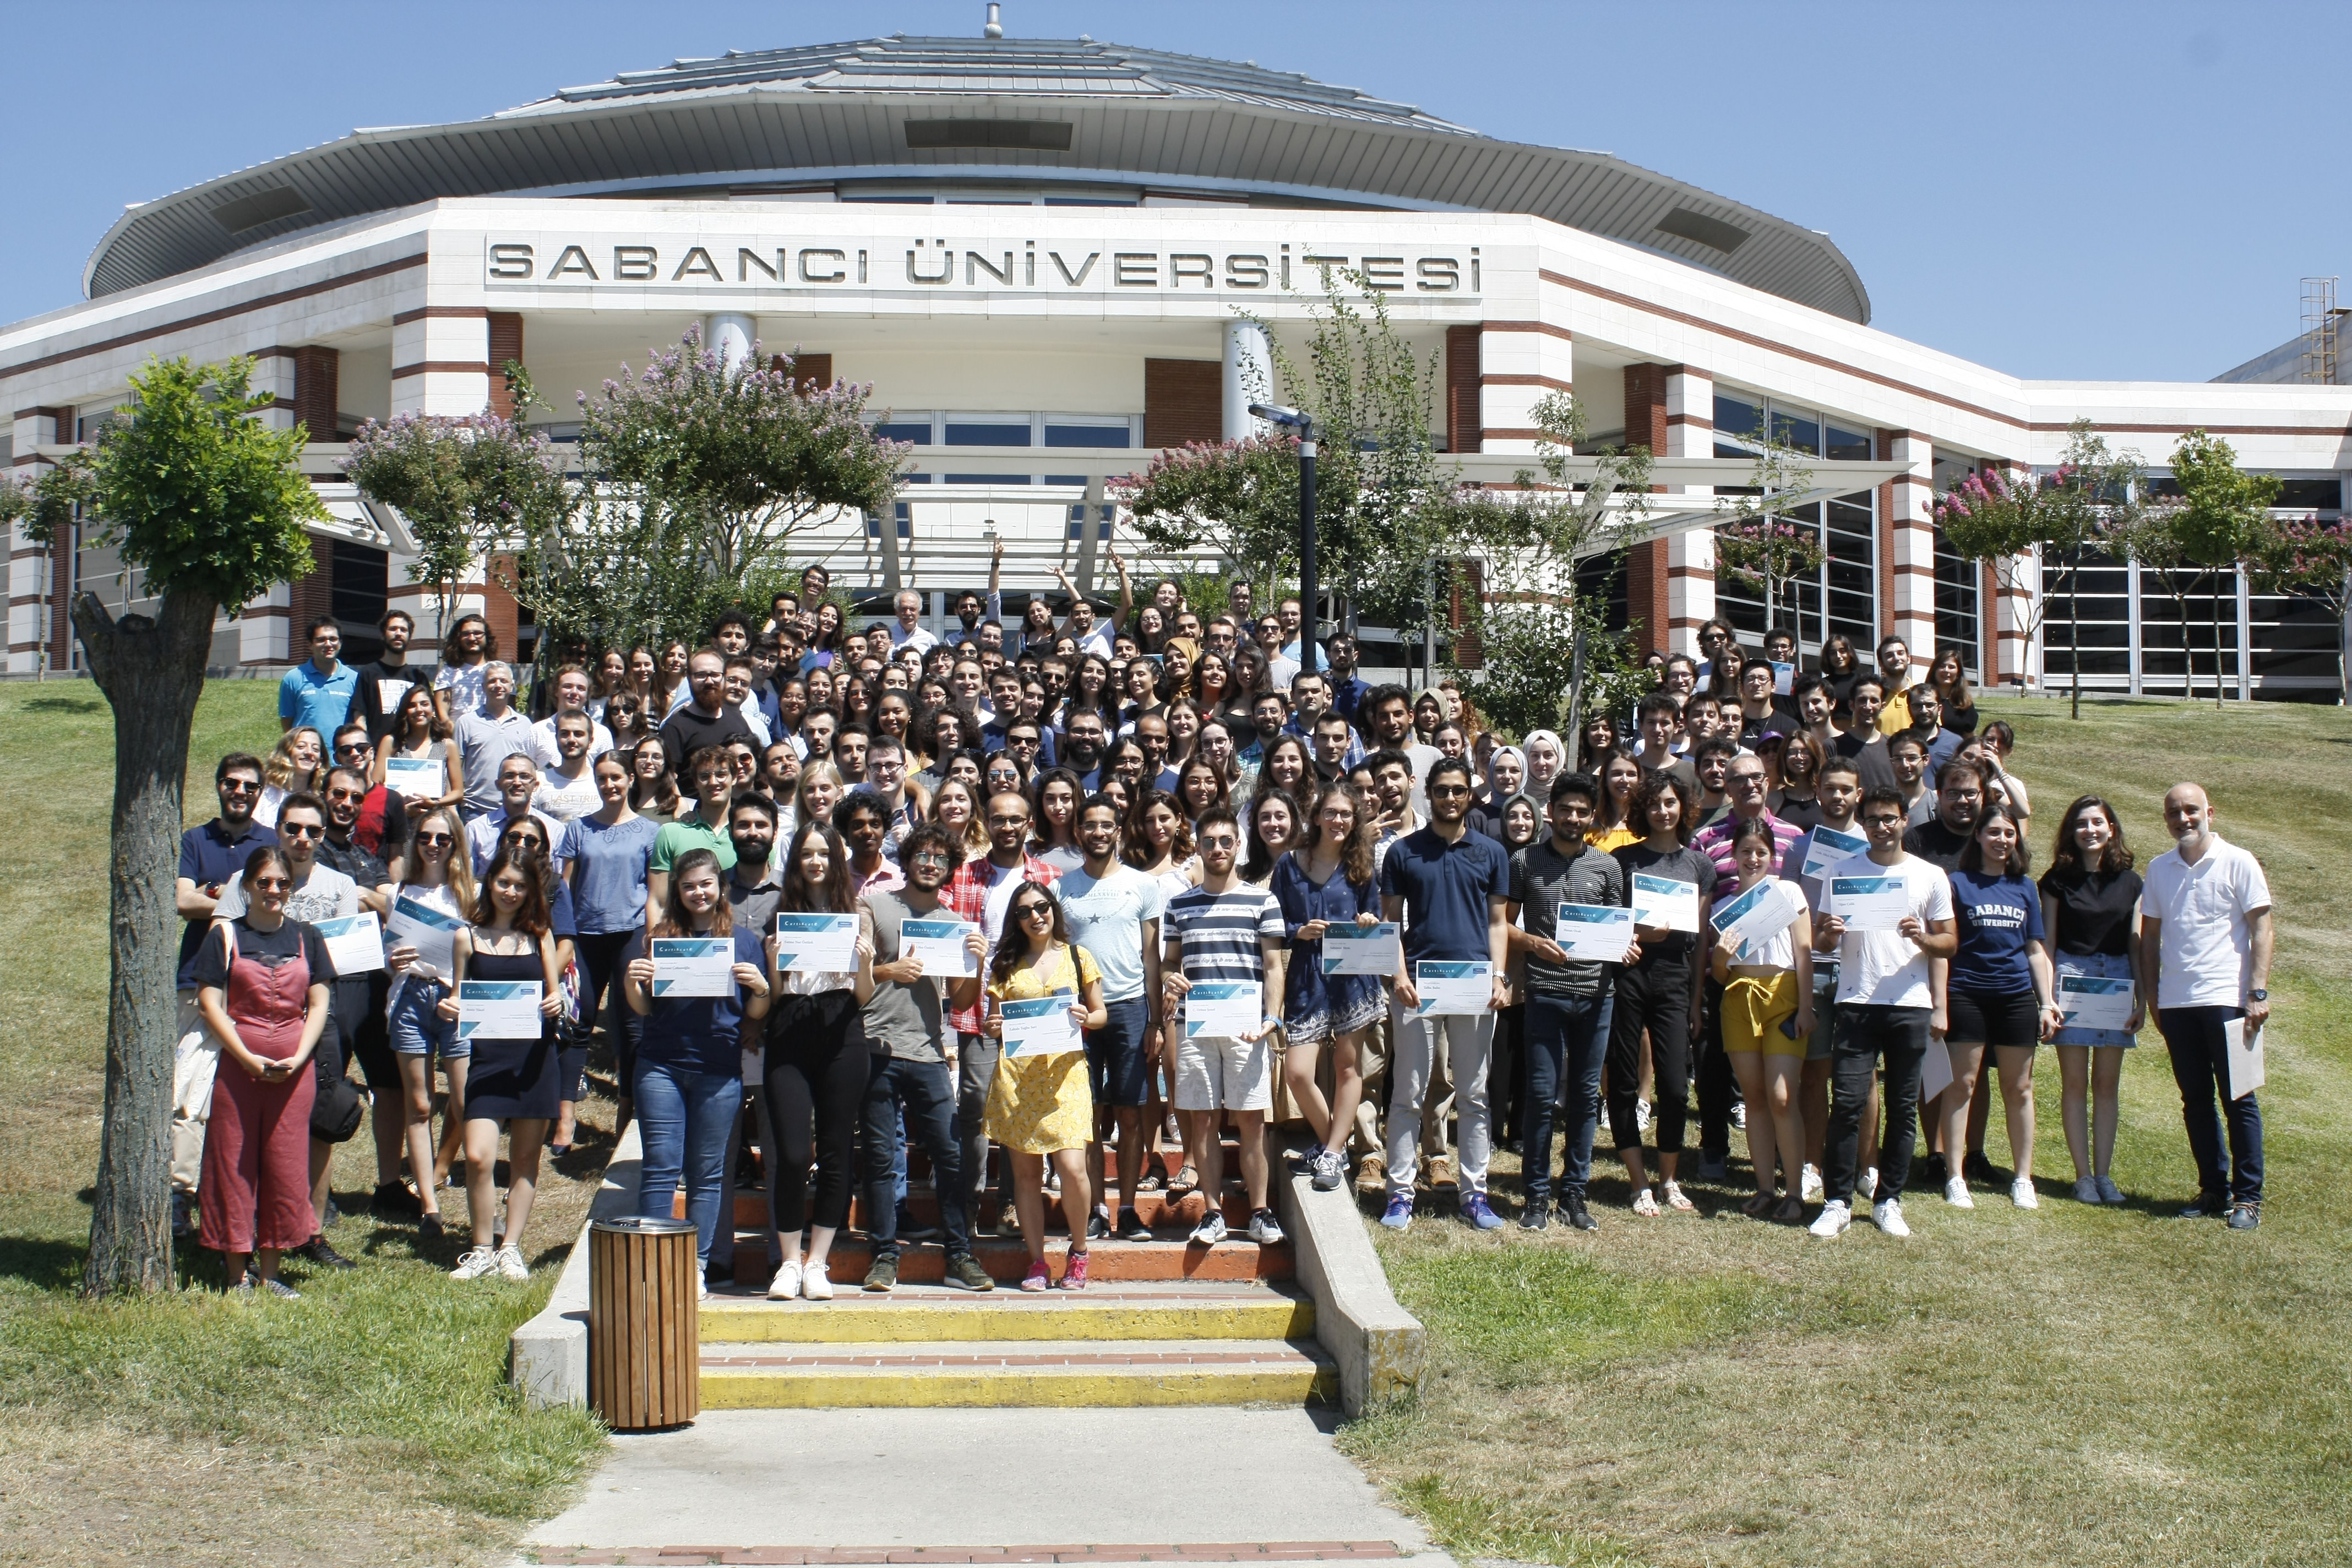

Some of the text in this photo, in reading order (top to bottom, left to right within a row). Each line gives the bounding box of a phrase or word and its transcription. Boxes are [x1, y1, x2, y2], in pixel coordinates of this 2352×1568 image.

[489, 244, 867, 284] SABANCI
[1638, 880, 1665, 889] Certificate
[401, 903, 431, 919] Certificate
[1720, 905, 1745, 924] Certificate
[1967, 903, 2025, 922] SABANCI
[1972, 918, 2022, 928] UNIVERSITY
